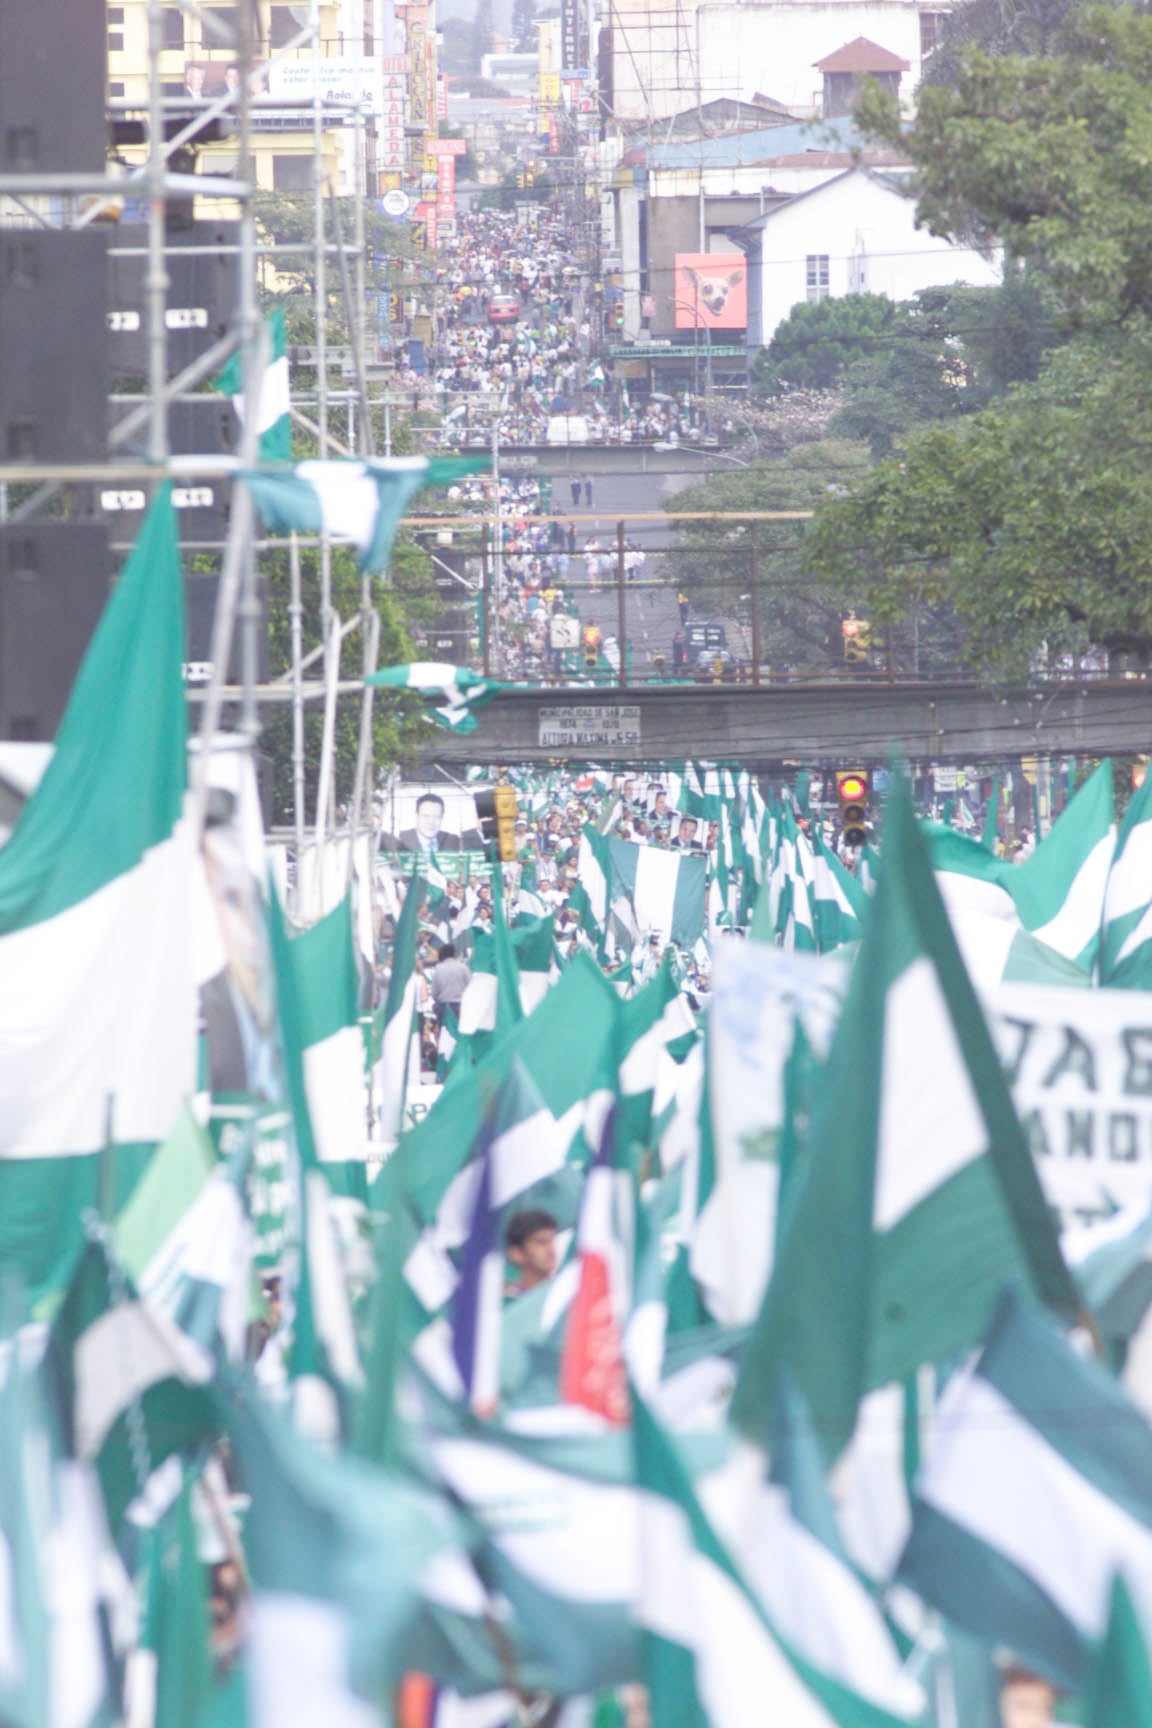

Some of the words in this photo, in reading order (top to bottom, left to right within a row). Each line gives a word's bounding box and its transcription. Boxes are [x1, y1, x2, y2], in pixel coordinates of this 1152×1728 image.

[565, 0, 575, 70] INTERNET
[388, 76, 400, 165] ALAMEDA
[605, 708, 619, 718] SAN
[543, 732, 575, 746] ALTURA
